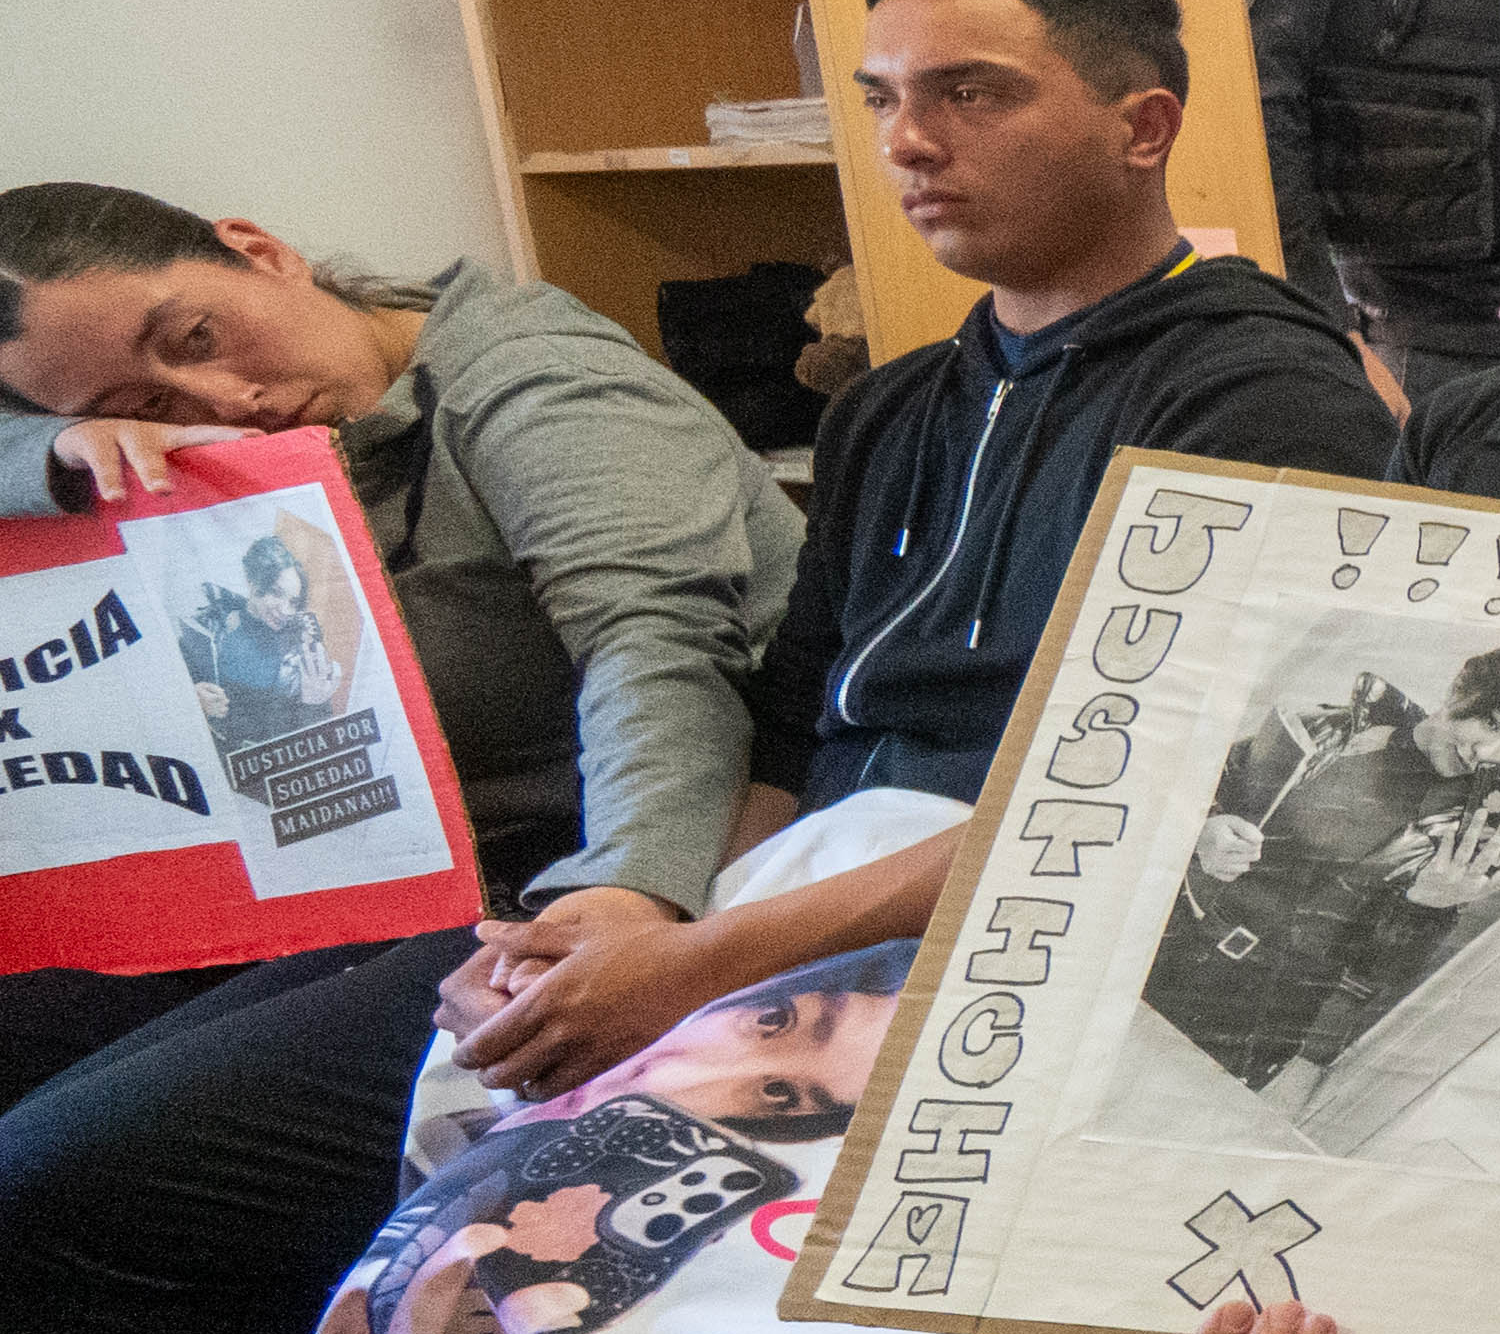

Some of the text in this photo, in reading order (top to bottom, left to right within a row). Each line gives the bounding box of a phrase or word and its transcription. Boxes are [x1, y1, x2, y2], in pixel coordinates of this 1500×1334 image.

[237, 717, 375, 781] JUSTICIA POR
[277, 758, 368, 802] SOLEDAD
[0, 750, 211, 817] EDAD
[277, 783, 395, 836] MAIDANA!!!
[841, 488, 1253, 1297] JUSTICIA
